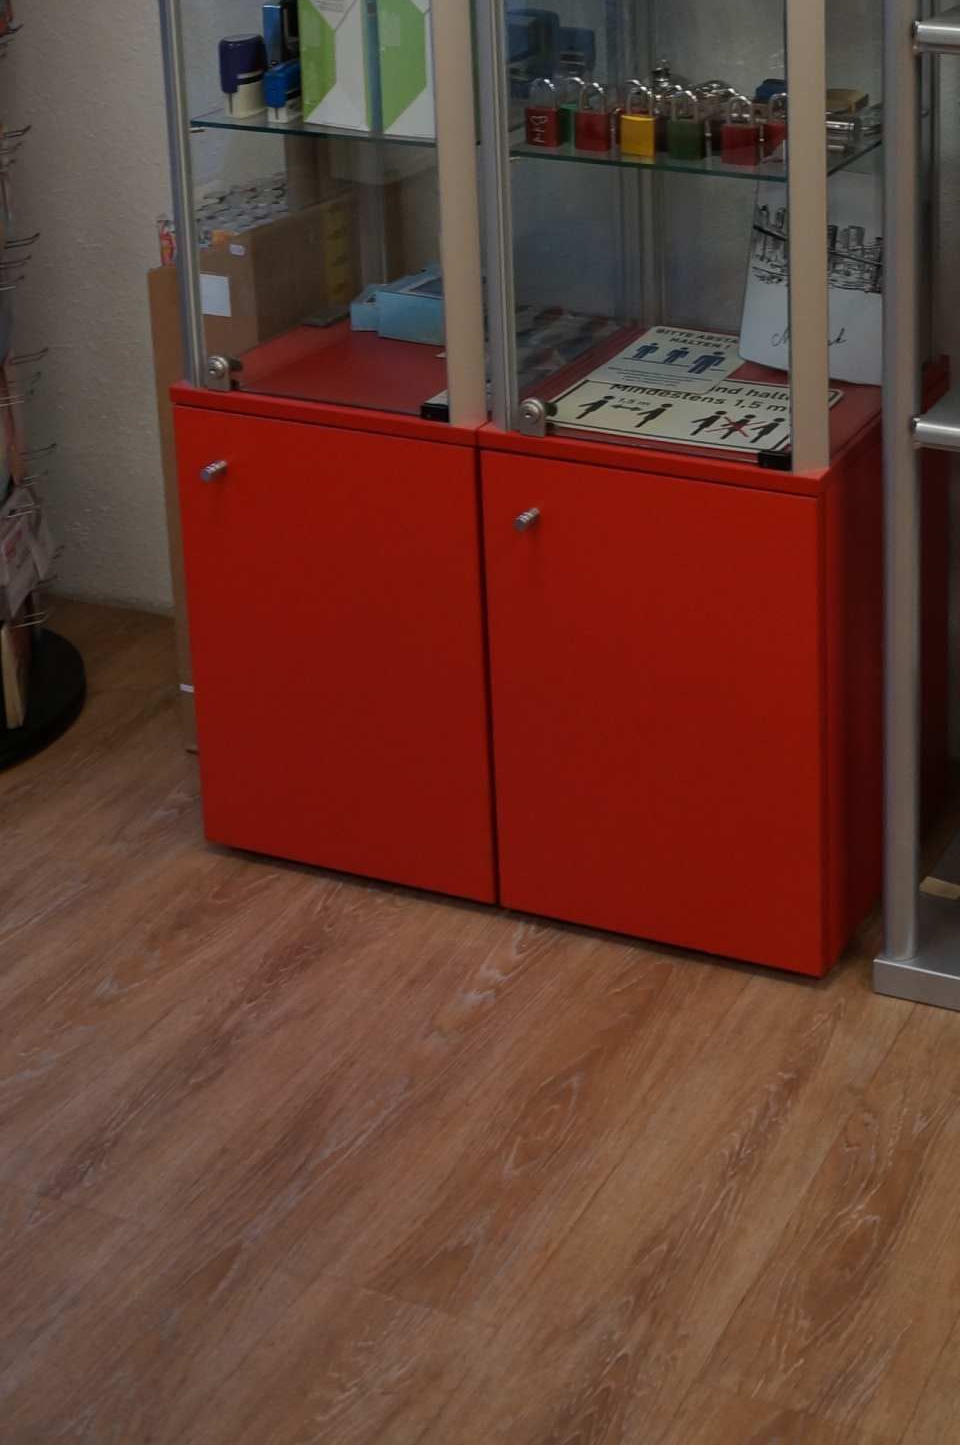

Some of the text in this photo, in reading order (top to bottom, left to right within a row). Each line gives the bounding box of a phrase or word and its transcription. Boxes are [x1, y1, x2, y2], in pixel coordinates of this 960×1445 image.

[656, 329, 739, 344] BITTE ABSTA
[609, 384, 787, 413] Mindestens 1,5 m
[618, 397, 639, 405] 1,5
[745, 388, 790, 401] halt
